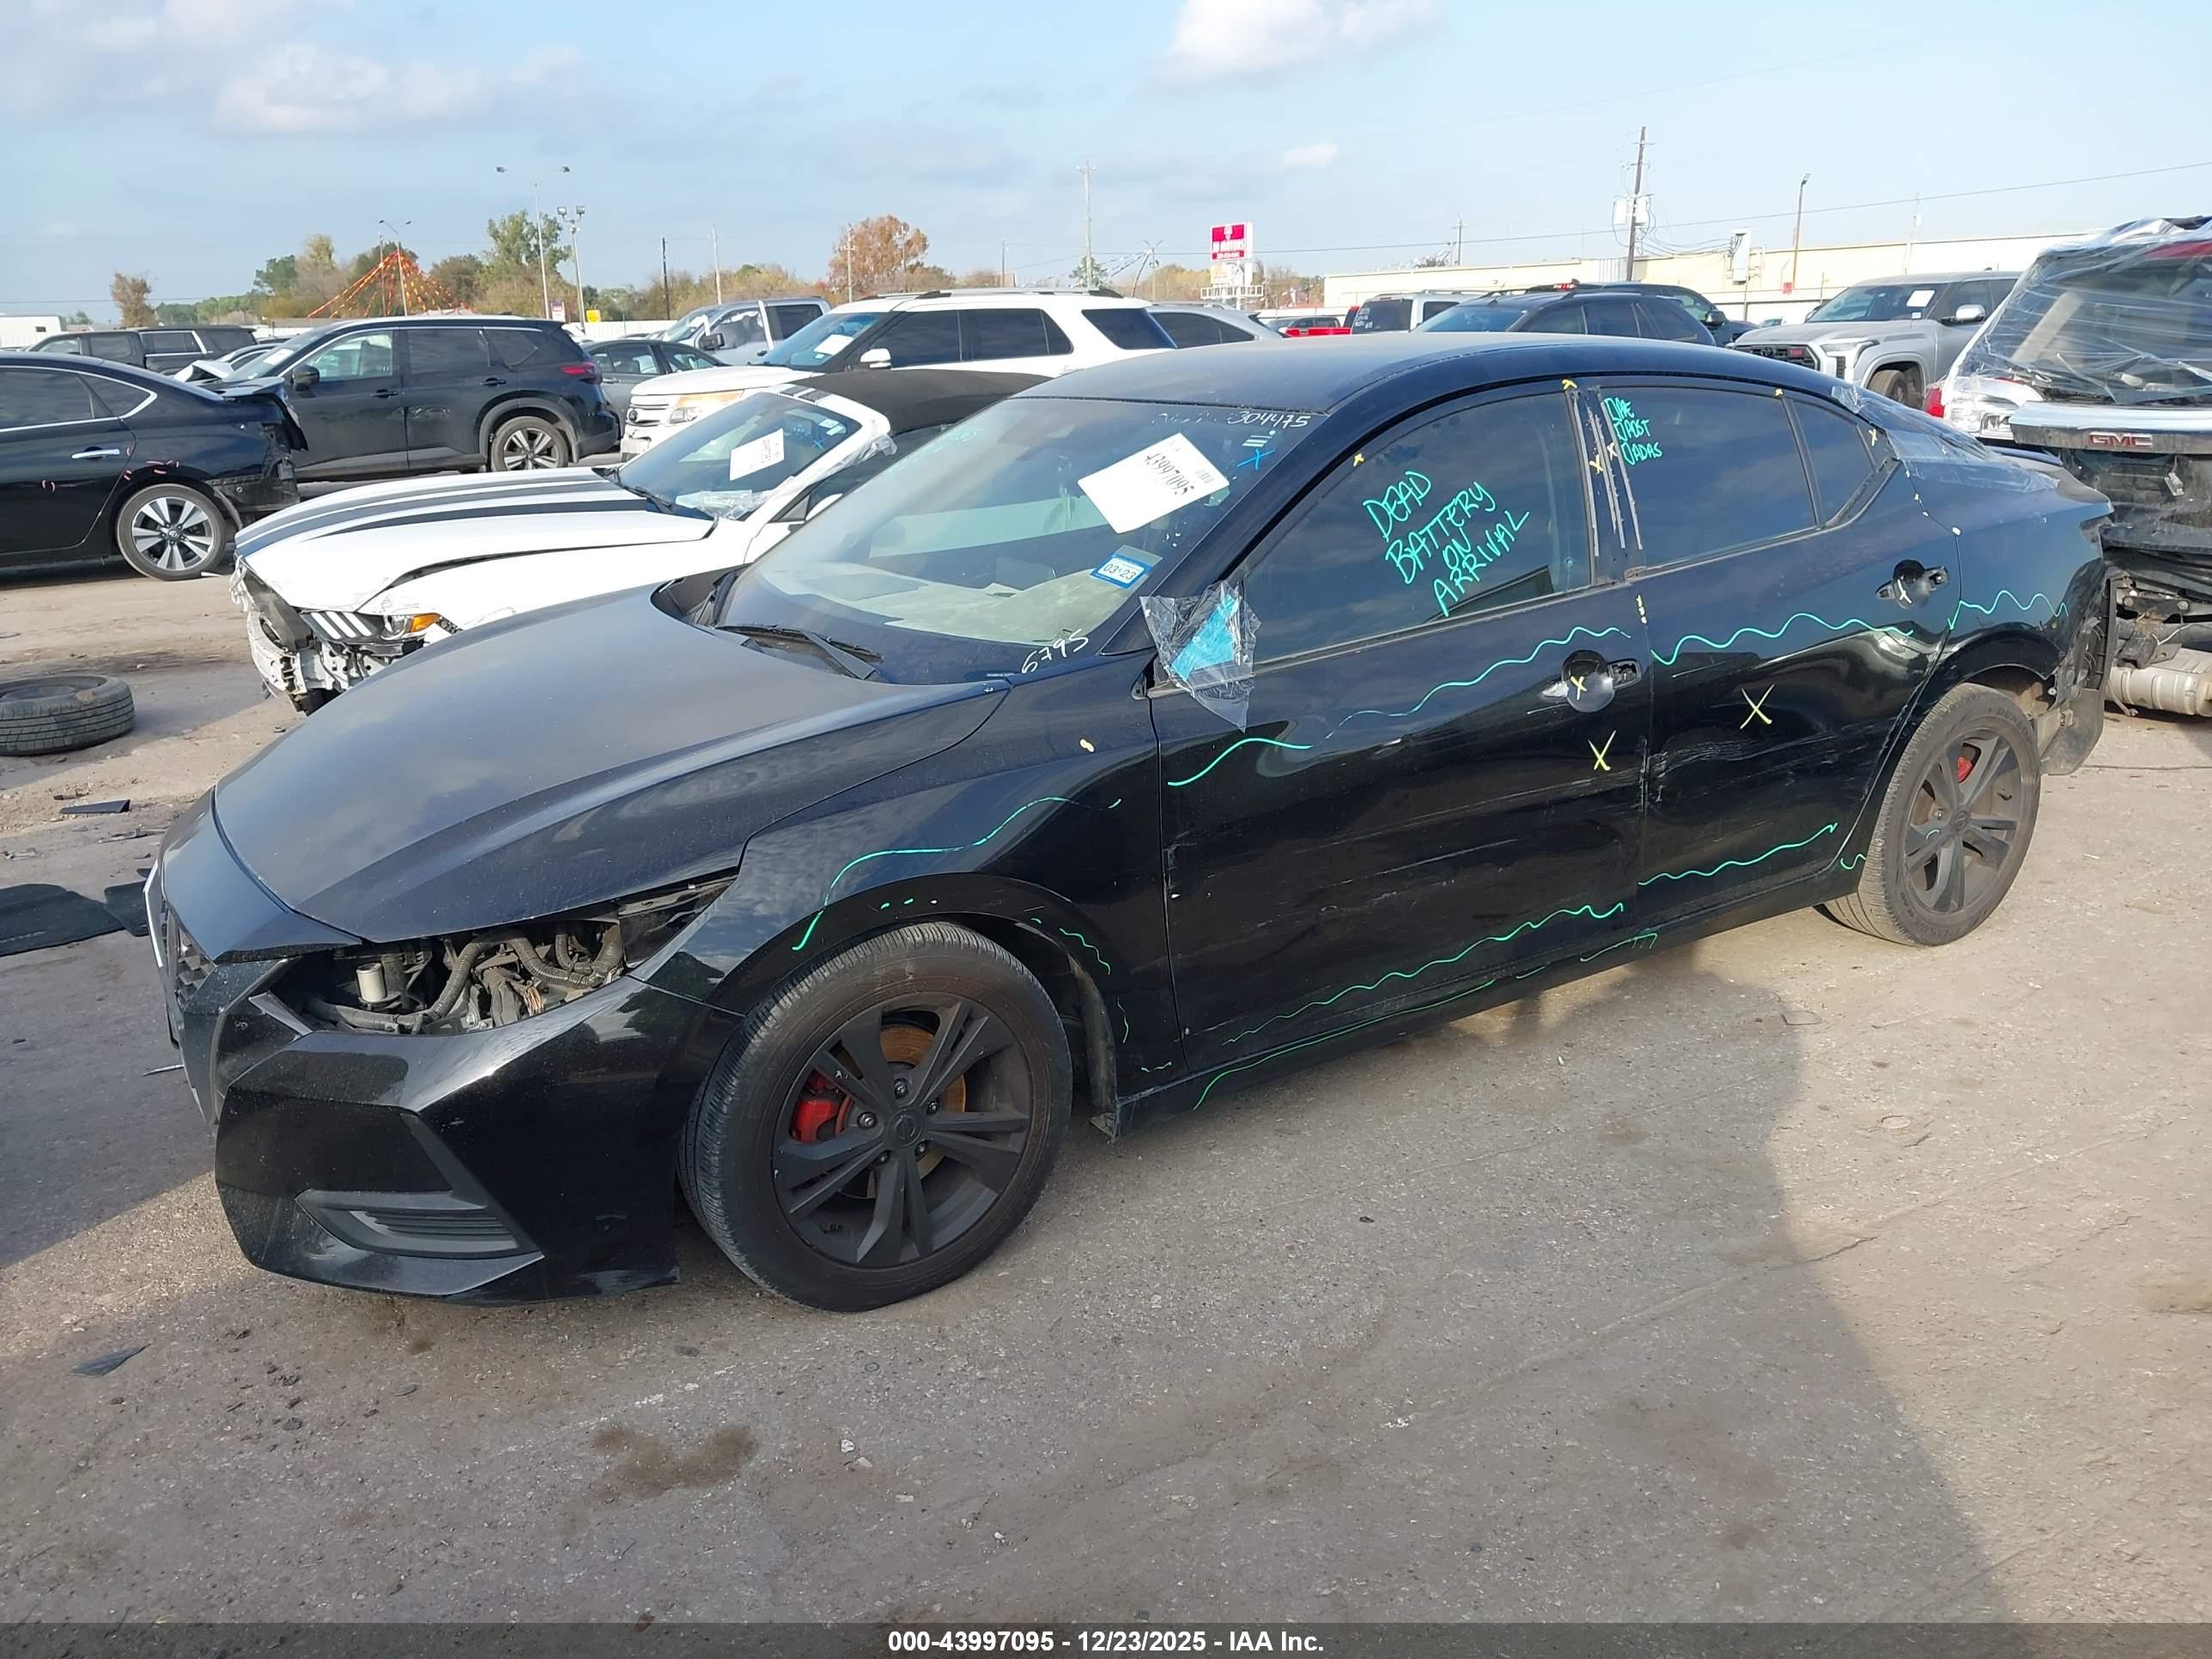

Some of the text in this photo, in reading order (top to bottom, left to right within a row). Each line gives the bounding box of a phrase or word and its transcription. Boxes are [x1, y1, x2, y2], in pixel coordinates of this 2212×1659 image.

[2088, 431, 2153, 447] GMC
[1145, 453, 1195, 495] 43997095
[1362, 471, 1431, 544] DEAD
[1384, 481, 1496, 585] BATTERY
[1433, 510, 1530, 617] ARRIVAL
[1442, 526, 1472, 570] ON
